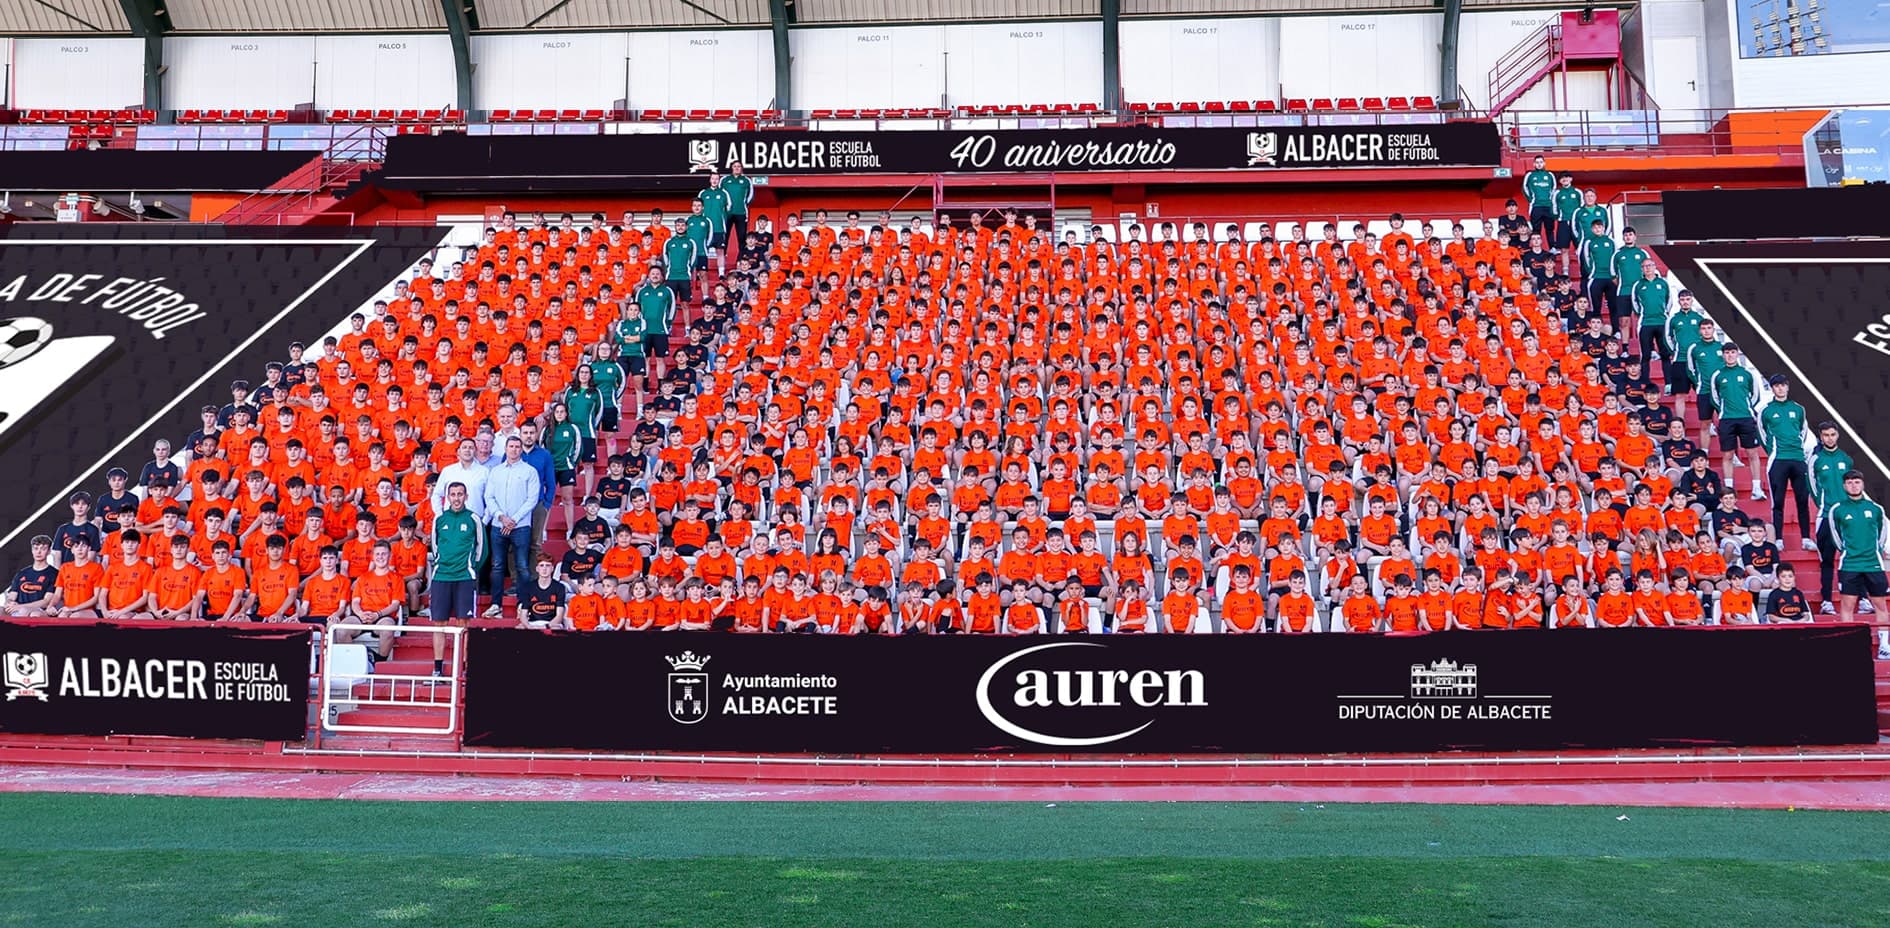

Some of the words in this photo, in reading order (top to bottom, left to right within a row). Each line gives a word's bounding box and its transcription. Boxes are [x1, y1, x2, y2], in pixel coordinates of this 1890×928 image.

[829, 141, 873, 154] ESCUELA
[1283, 134, 1384, 161] ALBACER
[1387, 133, 1431, 147] ESCUELA
[725, 141, 826, 168] ALBACER
[829, 155, 842, 167] DE
[844, 150, 881, 168] FÚTBOL
[950, 135, 996, 168] 40
[1004, 138, 1176, 167] aniversario
[1388, 148, 1400, 160] DE
[1403, 144, 1440, 160] FÚTBOL
[26, 273, 104, 302] DE
[80, 276, 207, 340] FÚTBOL
[59, 656, 208, 700] ALBACER
[214, 662, 278, 681] ESCUELA
[215, 682, 234, 701] DE
[237, 678, 291, 702] FÚTBOL
[722, 673, 837, 692] Ayuntamiento
[1013, 669, 1208, 707] auren
[722, 696, 837, 715] ALBACETE
[1338, 702, 1435, 720] DIPUTACIÓN
[1440, 705, 1461, 719] DE
[1467, 705, 1552, 719] ALBACETE
